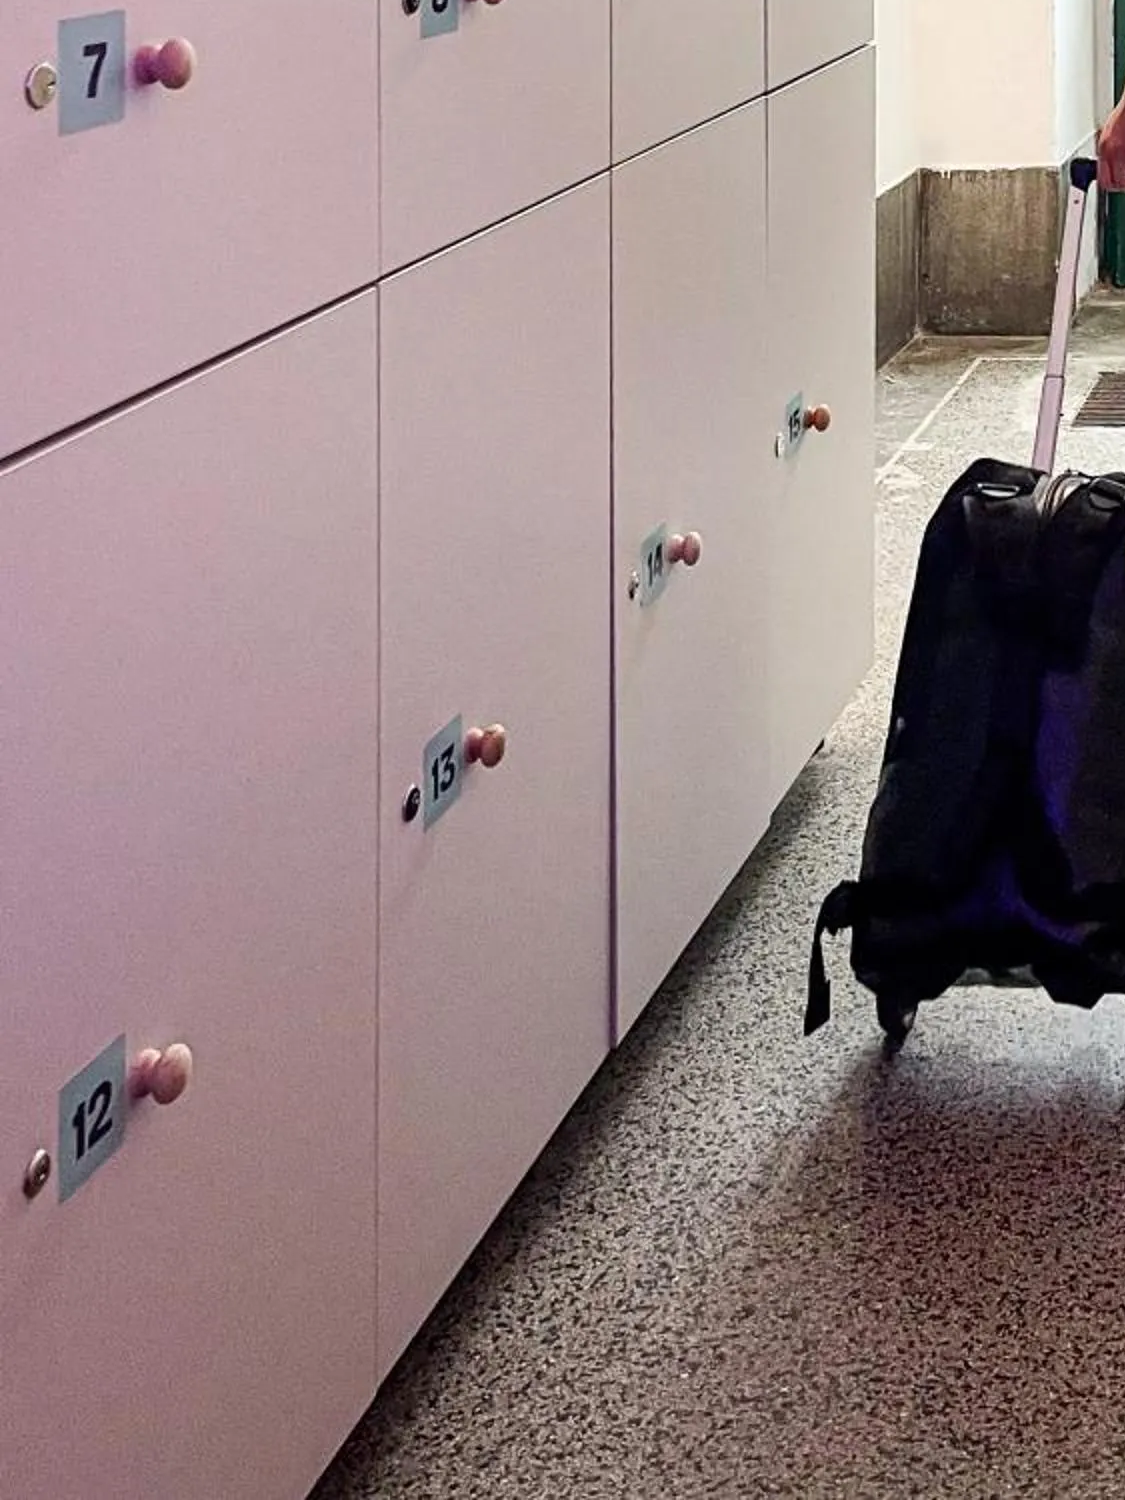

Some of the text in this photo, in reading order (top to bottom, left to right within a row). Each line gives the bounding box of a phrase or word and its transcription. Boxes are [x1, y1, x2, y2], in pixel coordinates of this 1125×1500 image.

[82, 41, 108, 99] 7
[788, 407, 801, 443] 15
[647, 542, 663, 587] 14
[431, 742, 455, 801] 13
[72, 1080, 113, 1161] 12
